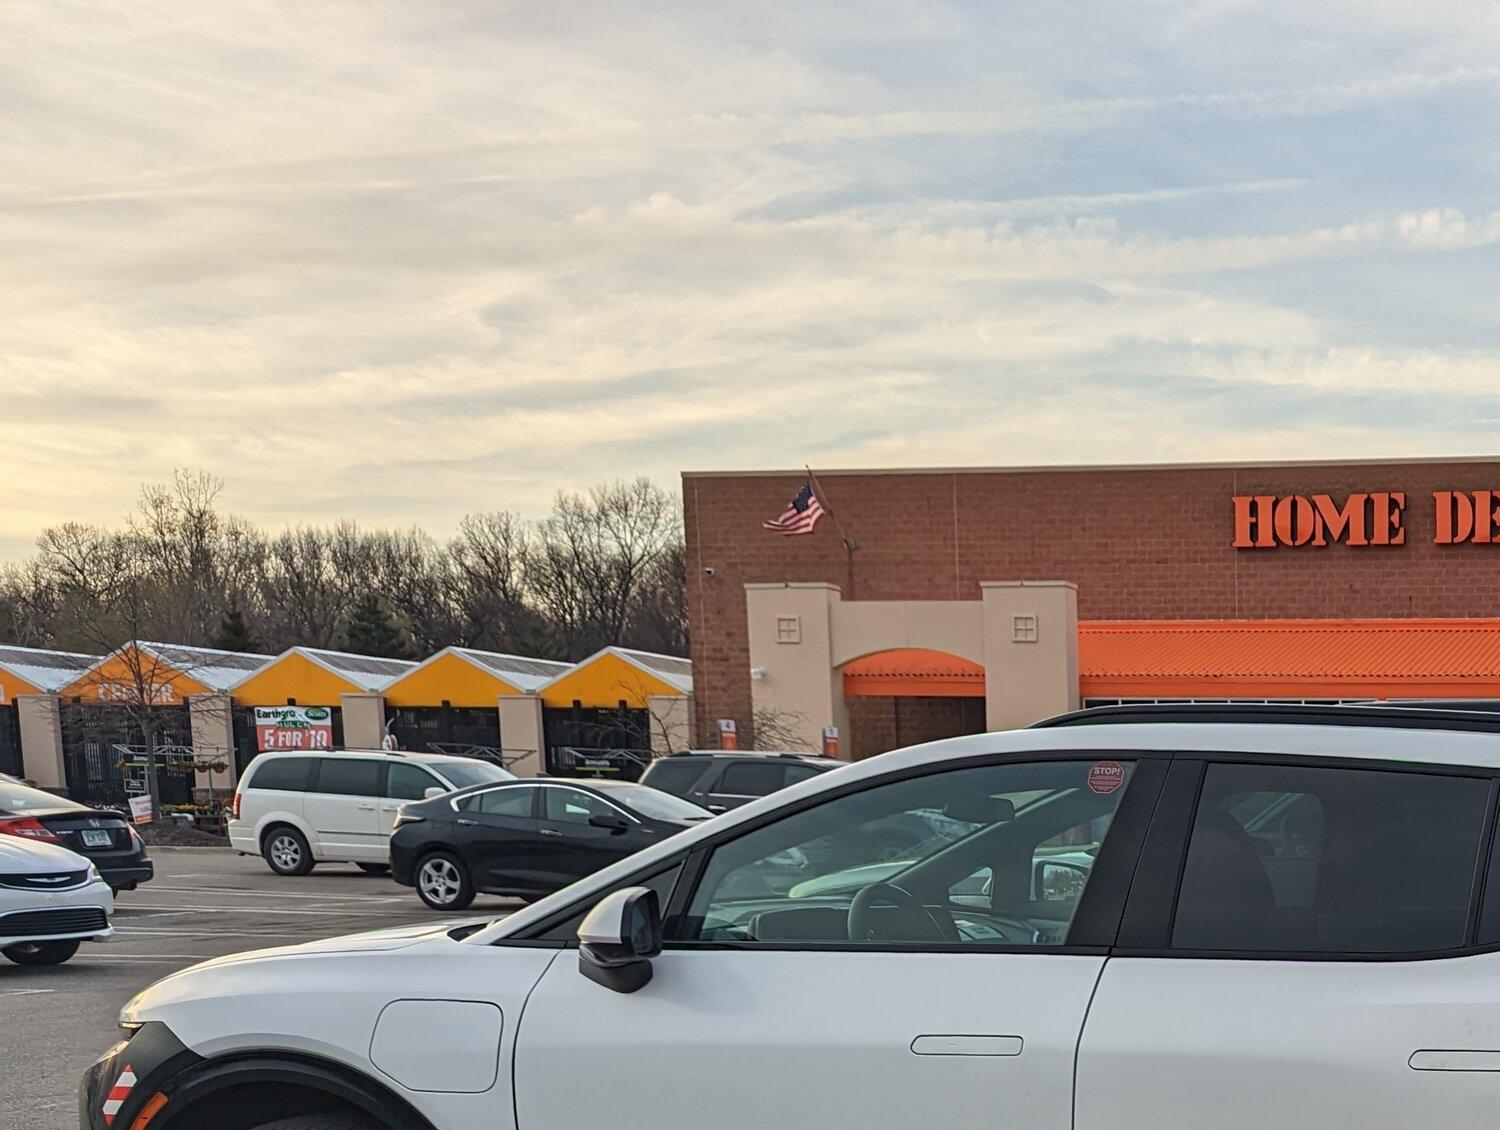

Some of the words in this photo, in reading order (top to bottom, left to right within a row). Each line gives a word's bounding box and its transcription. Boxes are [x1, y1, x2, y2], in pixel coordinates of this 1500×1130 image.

[1231, 492, 1406, 548] HOME
[264, 729, 274, 749] 5
[278, 730, 303, 747] FOR
[1094, 767, 1120, 775] STOP!
